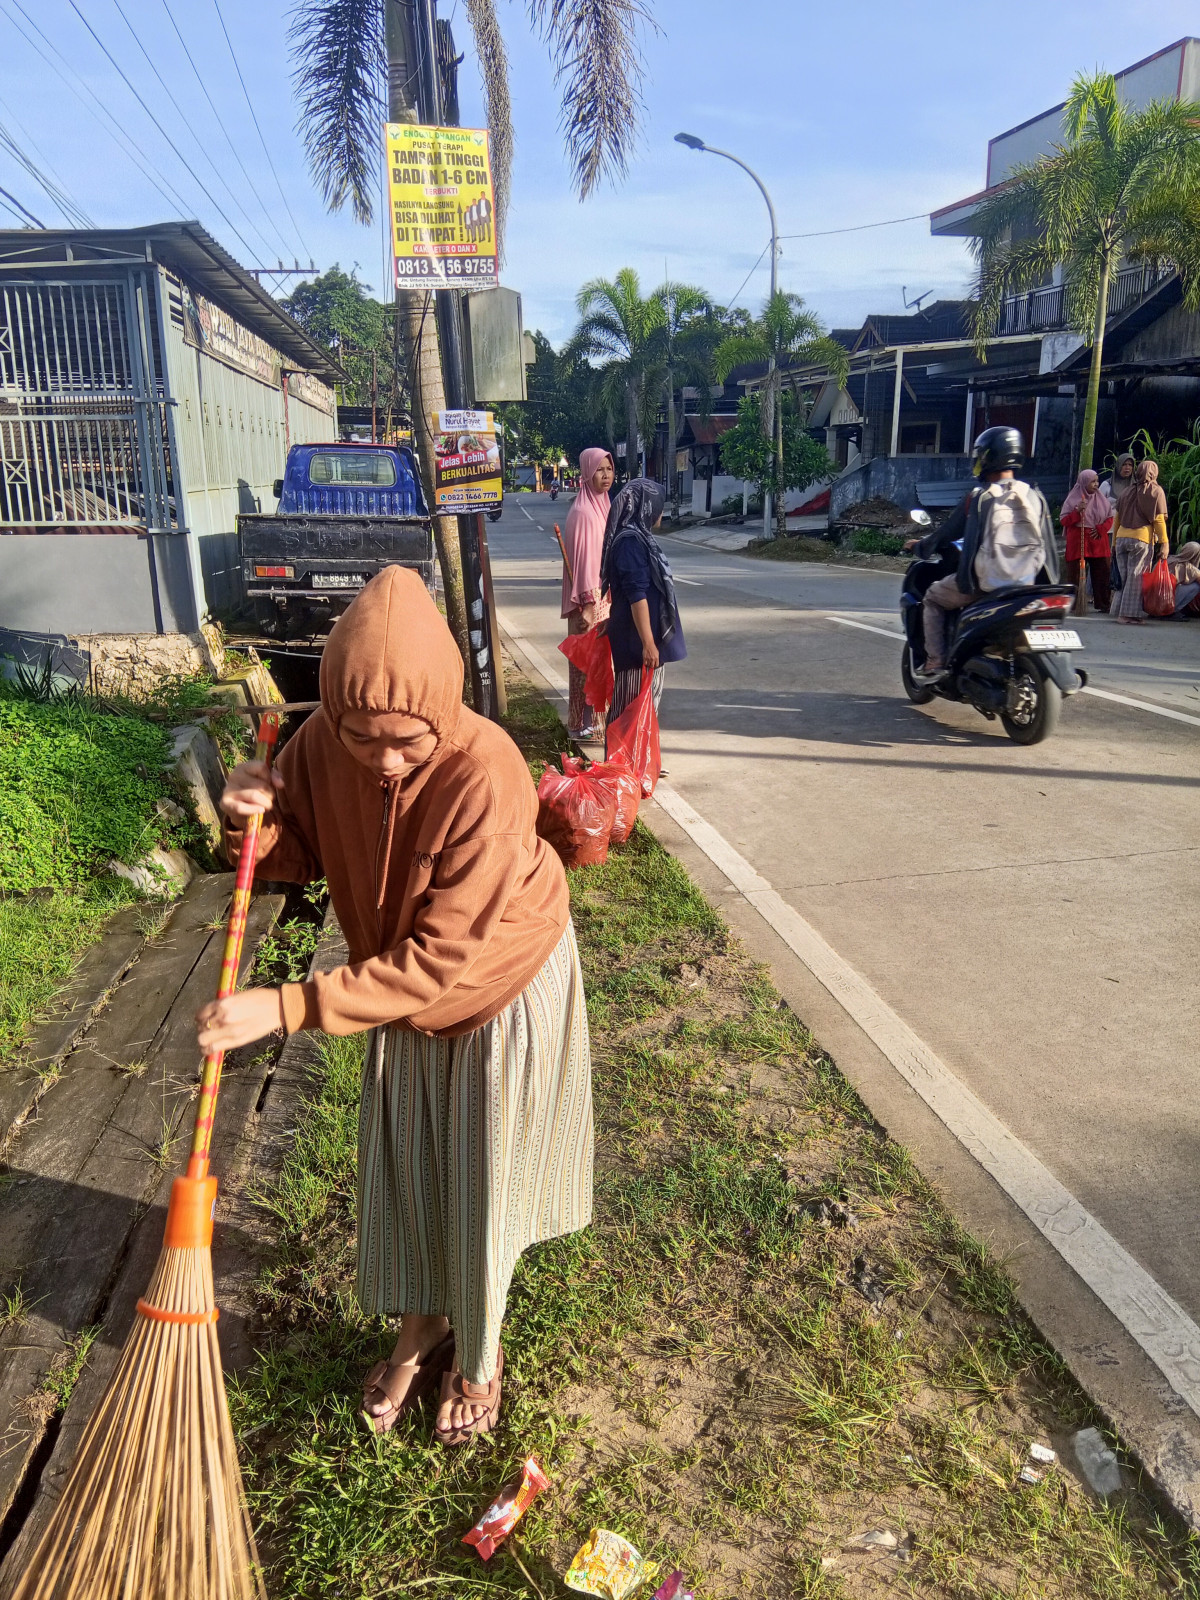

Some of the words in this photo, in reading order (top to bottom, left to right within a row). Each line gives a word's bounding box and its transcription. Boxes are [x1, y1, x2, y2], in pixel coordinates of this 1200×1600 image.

[412, 141, 436, 150] PUSAT
[437, 142, 464, 151] TERAPI
[444, 152, 484, 167] TINGGI
[392, 168, 438, 185] BADAN
[441, 169, 463, 184] 1-6
[465, 170, 488, 185] CM
[425, 187, 458, 195] TERBUKTI
[394, 200, 423, 209] HASILNYA
[423, 200, 454, 209] LANGSUNG
[395, 212, 419, 224] BISA
[420, 212, 456, 224] DILIHAT
[396, 227, 410, 242] DI
[411, 227, 456, 242] TEMPAT
[471, 244, 476, 252] X
[398, 259, 429, 275] 0813
[464, 258, 494, 274] 9755
[440, 457, 460, 468] Jelas
[462, 452, 485, 464] Lebih
[441, 462, 496, 481] BERKUALITAS
[483, 491, 498, 499] 7778
